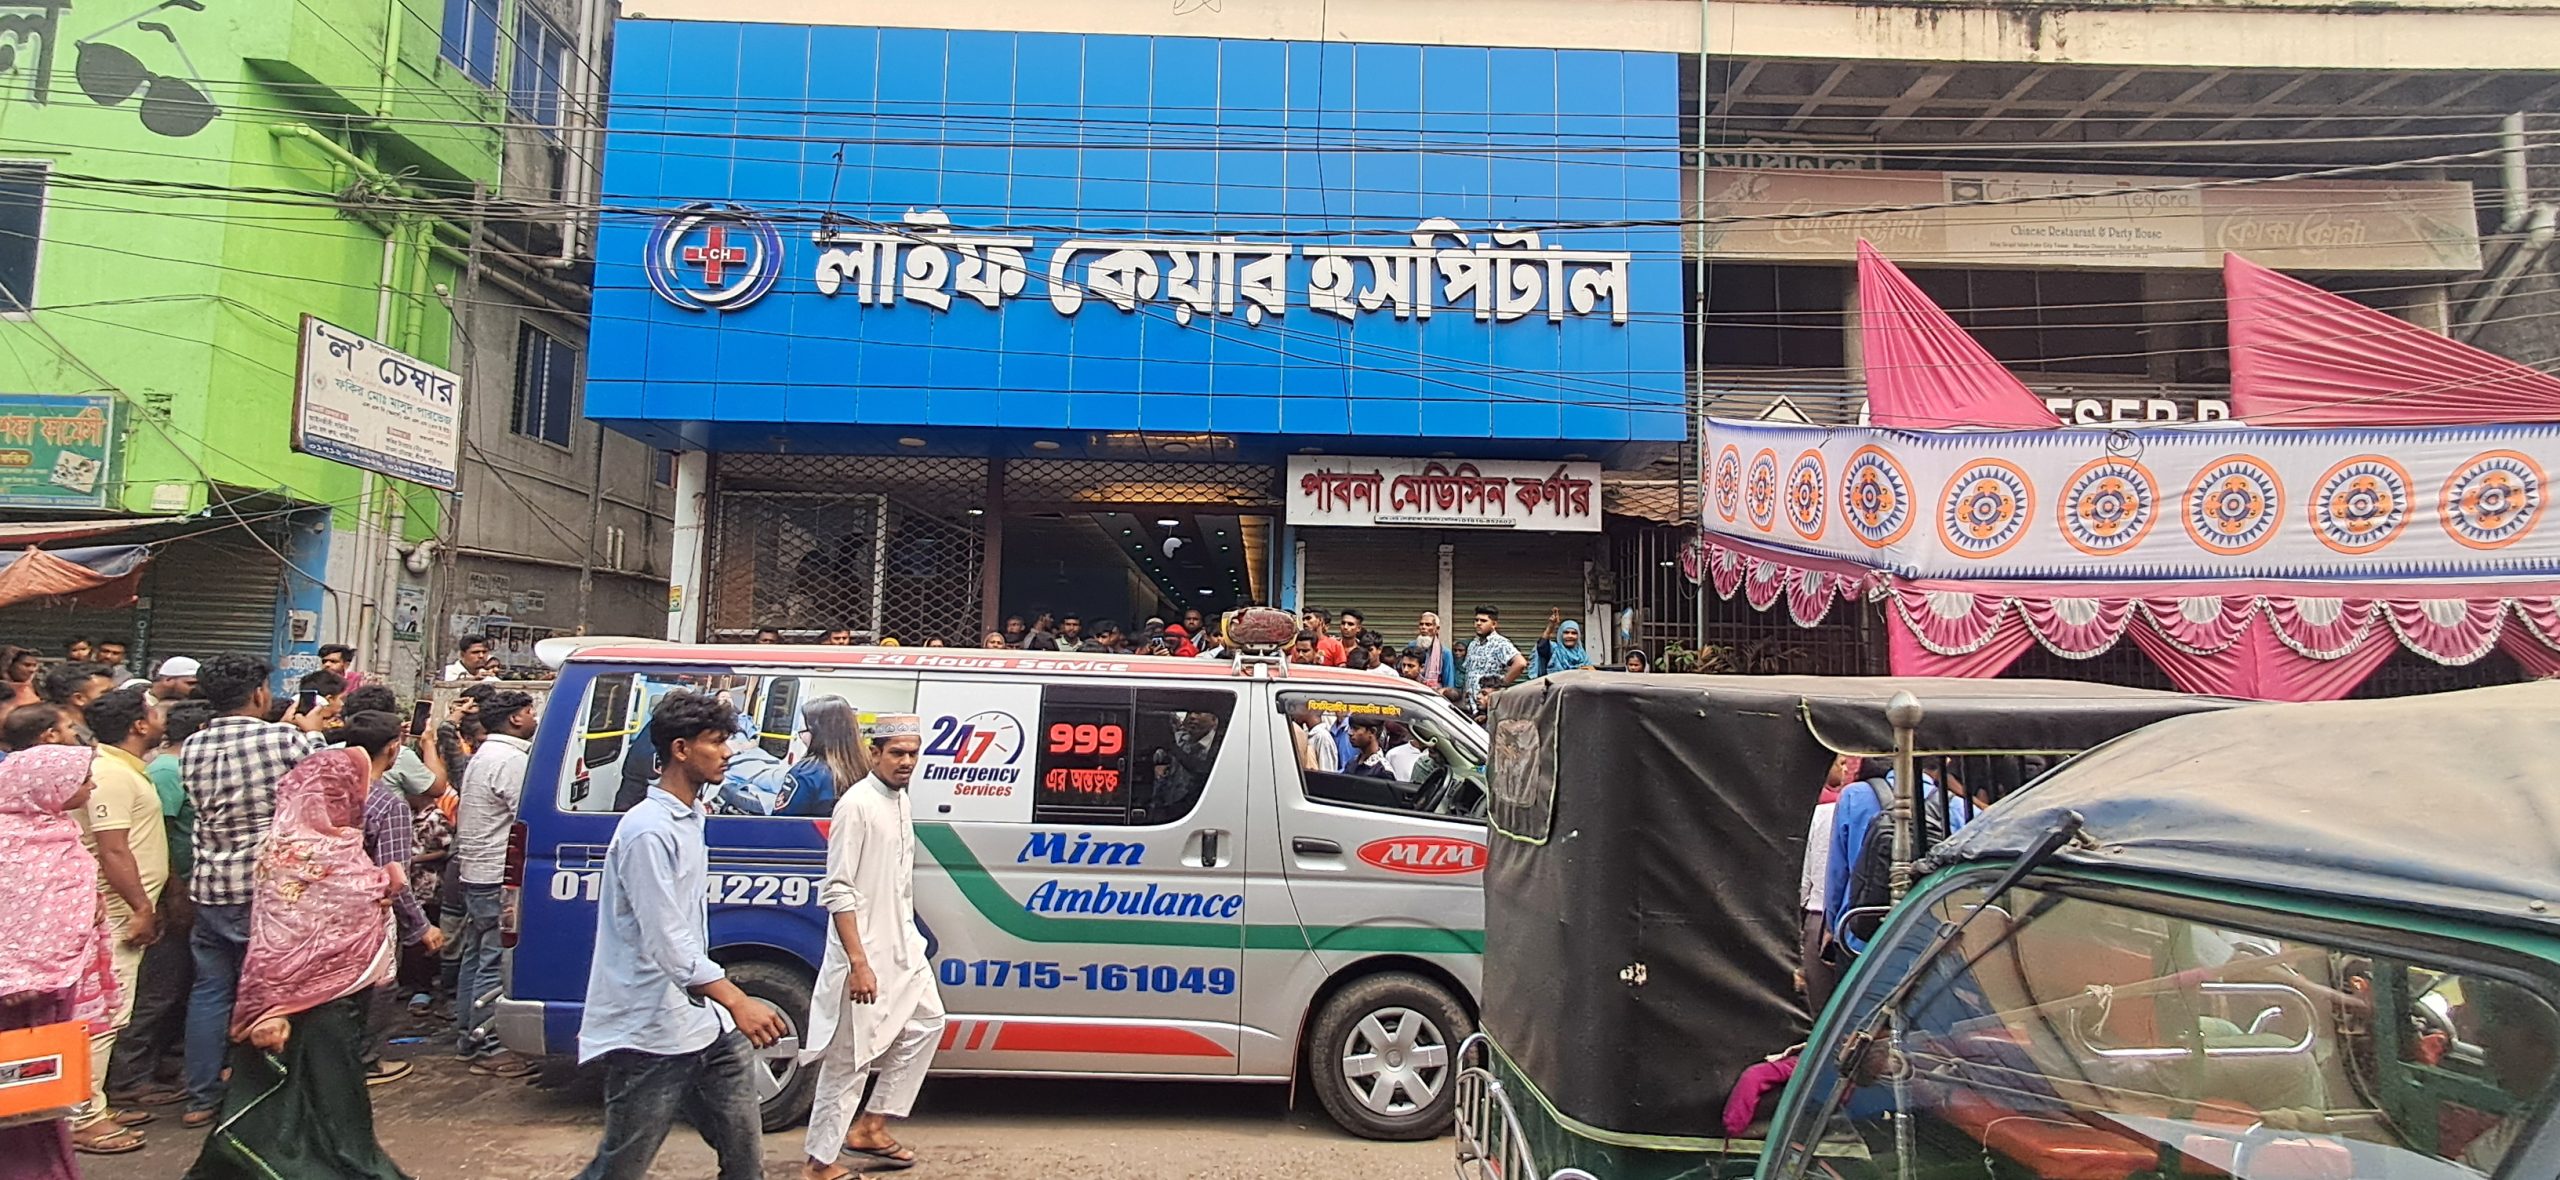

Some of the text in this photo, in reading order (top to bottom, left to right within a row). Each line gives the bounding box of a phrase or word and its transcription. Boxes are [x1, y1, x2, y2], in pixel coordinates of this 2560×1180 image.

[2011, 225, 2047, 237] Chinese
[2049, 225, 2096, 239] Restaurant
[2108, 227, 2133, 241] Party
[2135, 226, 2162, 239] House
[698, 248, 731, 261] LCH
[812, 206, 1632, 327] লাইফ কেয়ার হসপিটাল
[379, 357, 457, 407] চেম্বার
[1301, 462, 1593, 518] পাবনা মেডিসিন কর্ণার
[861, 653, 1129, 672] 24 Hours Service
[1049, 723, 1123, 755] 999
[923, 763, 1021, 784] Emergency
[1046, 768, 1067, 793] এর
[953, 782, 1012, 797] Services
[97, 804, 108, 819] 3
[1017, 831, 1146, 866] Mim
[1380, 843, 1474, 867] MIM
[1024, 879, 1244, 918] Ambulance
[939, 957, 1236, 996] 01715-161049
